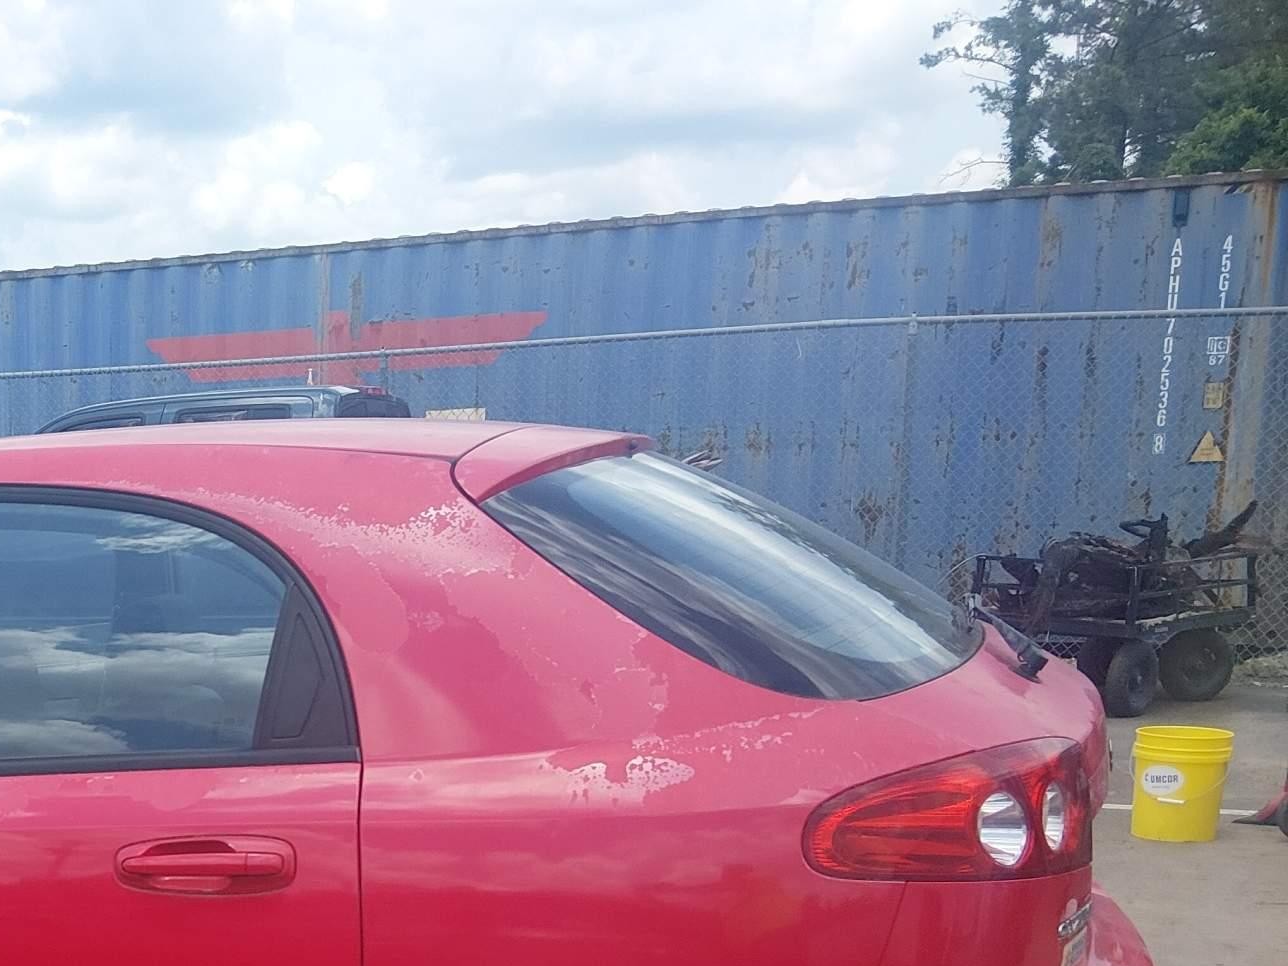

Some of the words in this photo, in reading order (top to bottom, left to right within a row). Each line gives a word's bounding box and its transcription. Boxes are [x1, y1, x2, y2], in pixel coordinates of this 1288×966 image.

[1167, 238, 1183, 312] APHU
[1218, 234, 1233, 312] 45G1
[1156, 317, 1177, 427] 702536
[1208, 354, 1225, 366] 87
